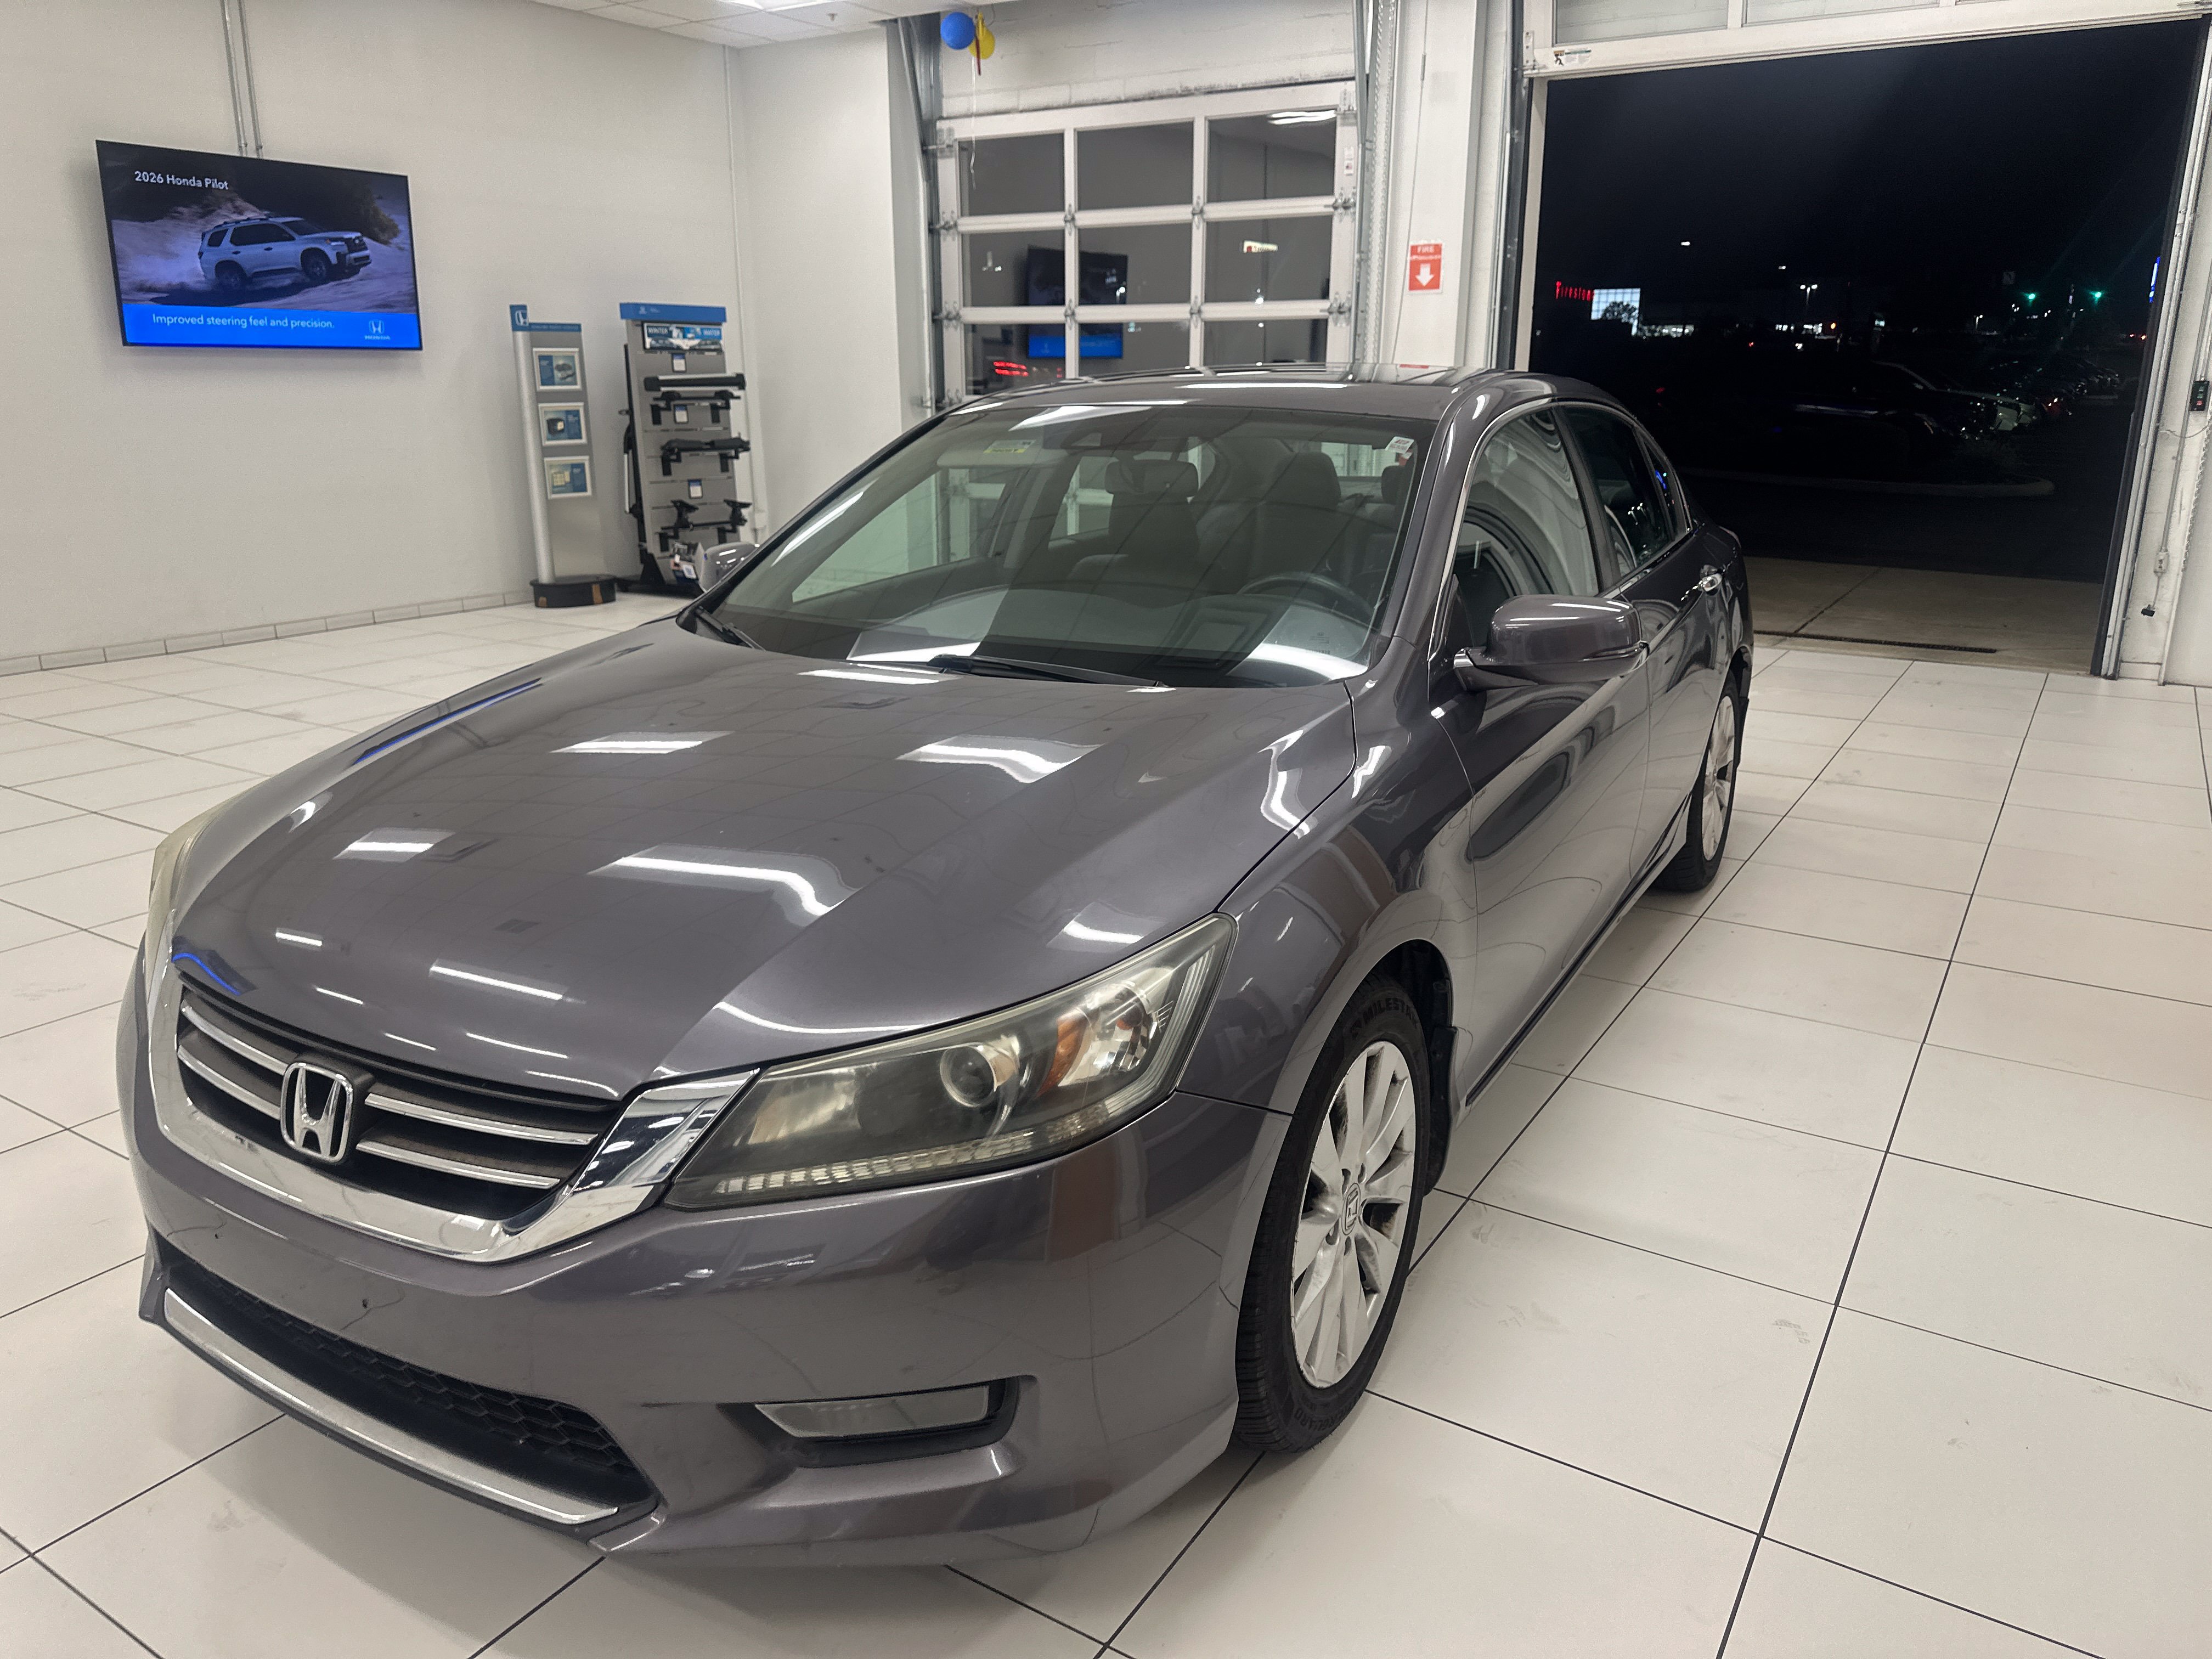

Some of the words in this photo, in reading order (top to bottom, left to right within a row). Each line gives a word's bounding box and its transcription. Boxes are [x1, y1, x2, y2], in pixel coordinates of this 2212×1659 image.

[134, 171, 164, 184] 2026
[166, 174, 202, 188] Honda
[204, 177, 229, 190] Pilot
[153, 313, 204, 326] Improved
[206, 315, 247, 328] steering
[249, 315, 267, 326] feel
[270, 317, 288, 327] and
[291, 318, 335, 329] precision.
